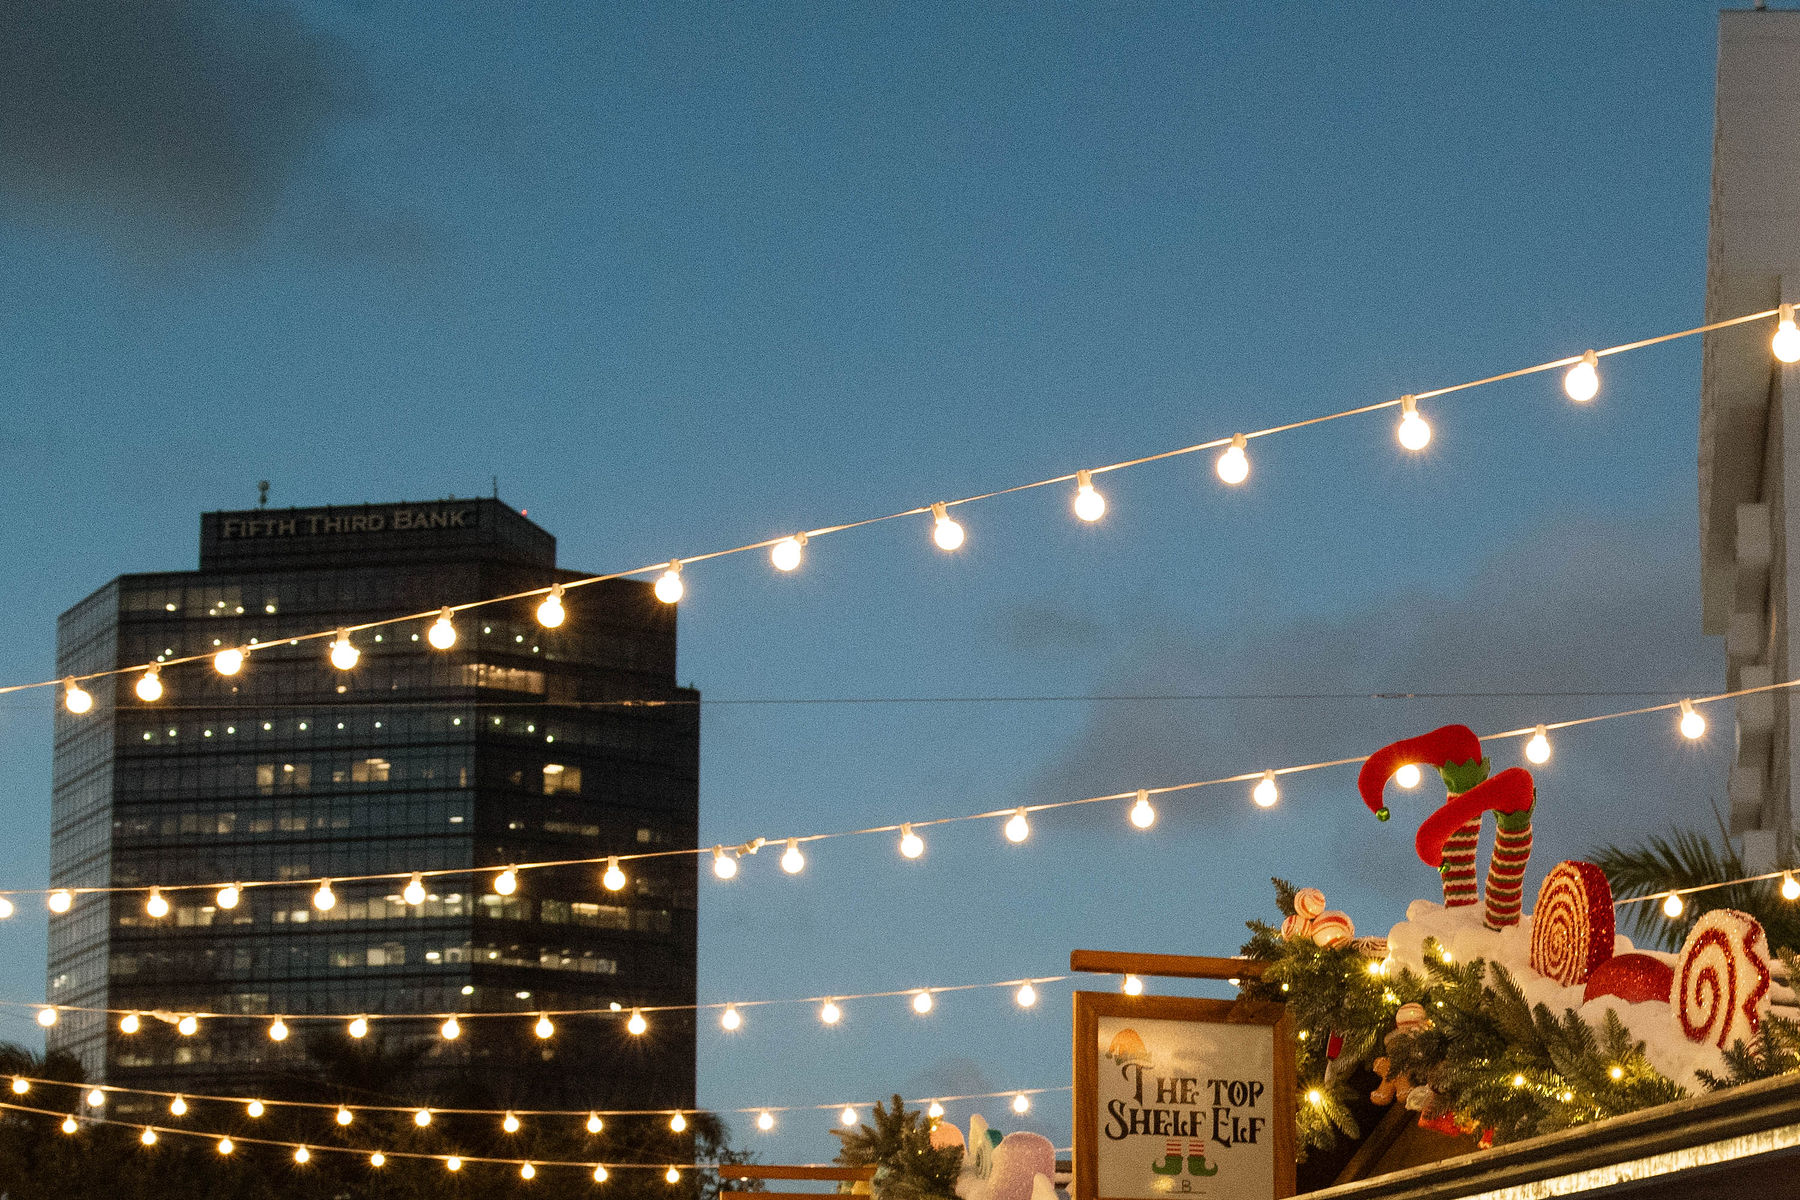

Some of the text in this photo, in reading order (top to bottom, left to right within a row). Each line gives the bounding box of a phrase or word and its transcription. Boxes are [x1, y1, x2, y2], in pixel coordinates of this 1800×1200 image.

[224, 510, 466, 538] FIFTH THIRD BANK
[1122, 1063, 1264, 1108] THE TOP
[1104, 1098, 1266, 1148] SHELF ELF
